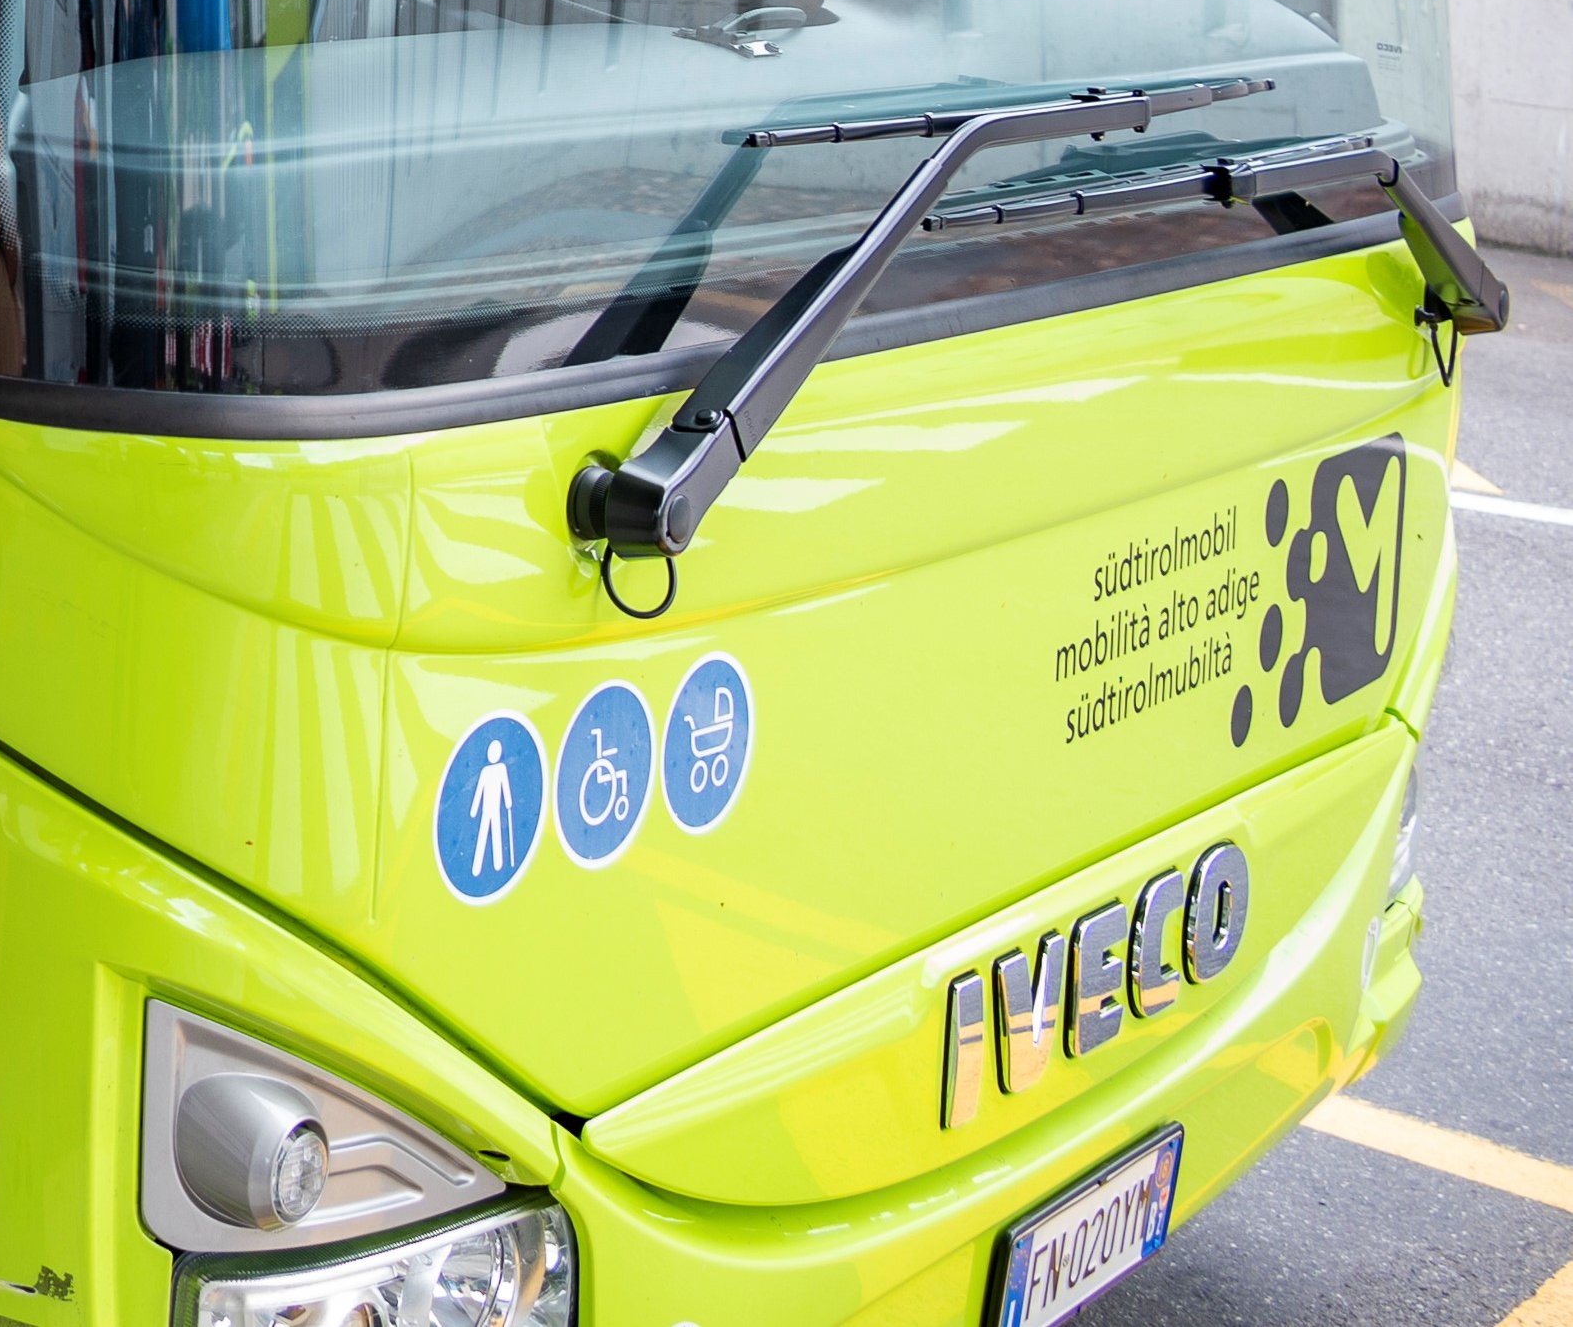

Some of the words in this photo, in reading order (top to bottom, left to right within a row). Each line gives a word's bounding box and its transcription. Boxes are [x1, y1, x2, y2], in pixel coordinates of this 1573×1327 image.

[1093, 505, 1238, 602] südtirolmobil
[1055, 603, 1151, 682] mobilità
[1158, 589, 1199, 641] alto
[1205, 569, 1260, 620] adige
[1065, 631, 1233, 744] südtirolmubiltà
[940, 838, 1249, 1131] IVECO
